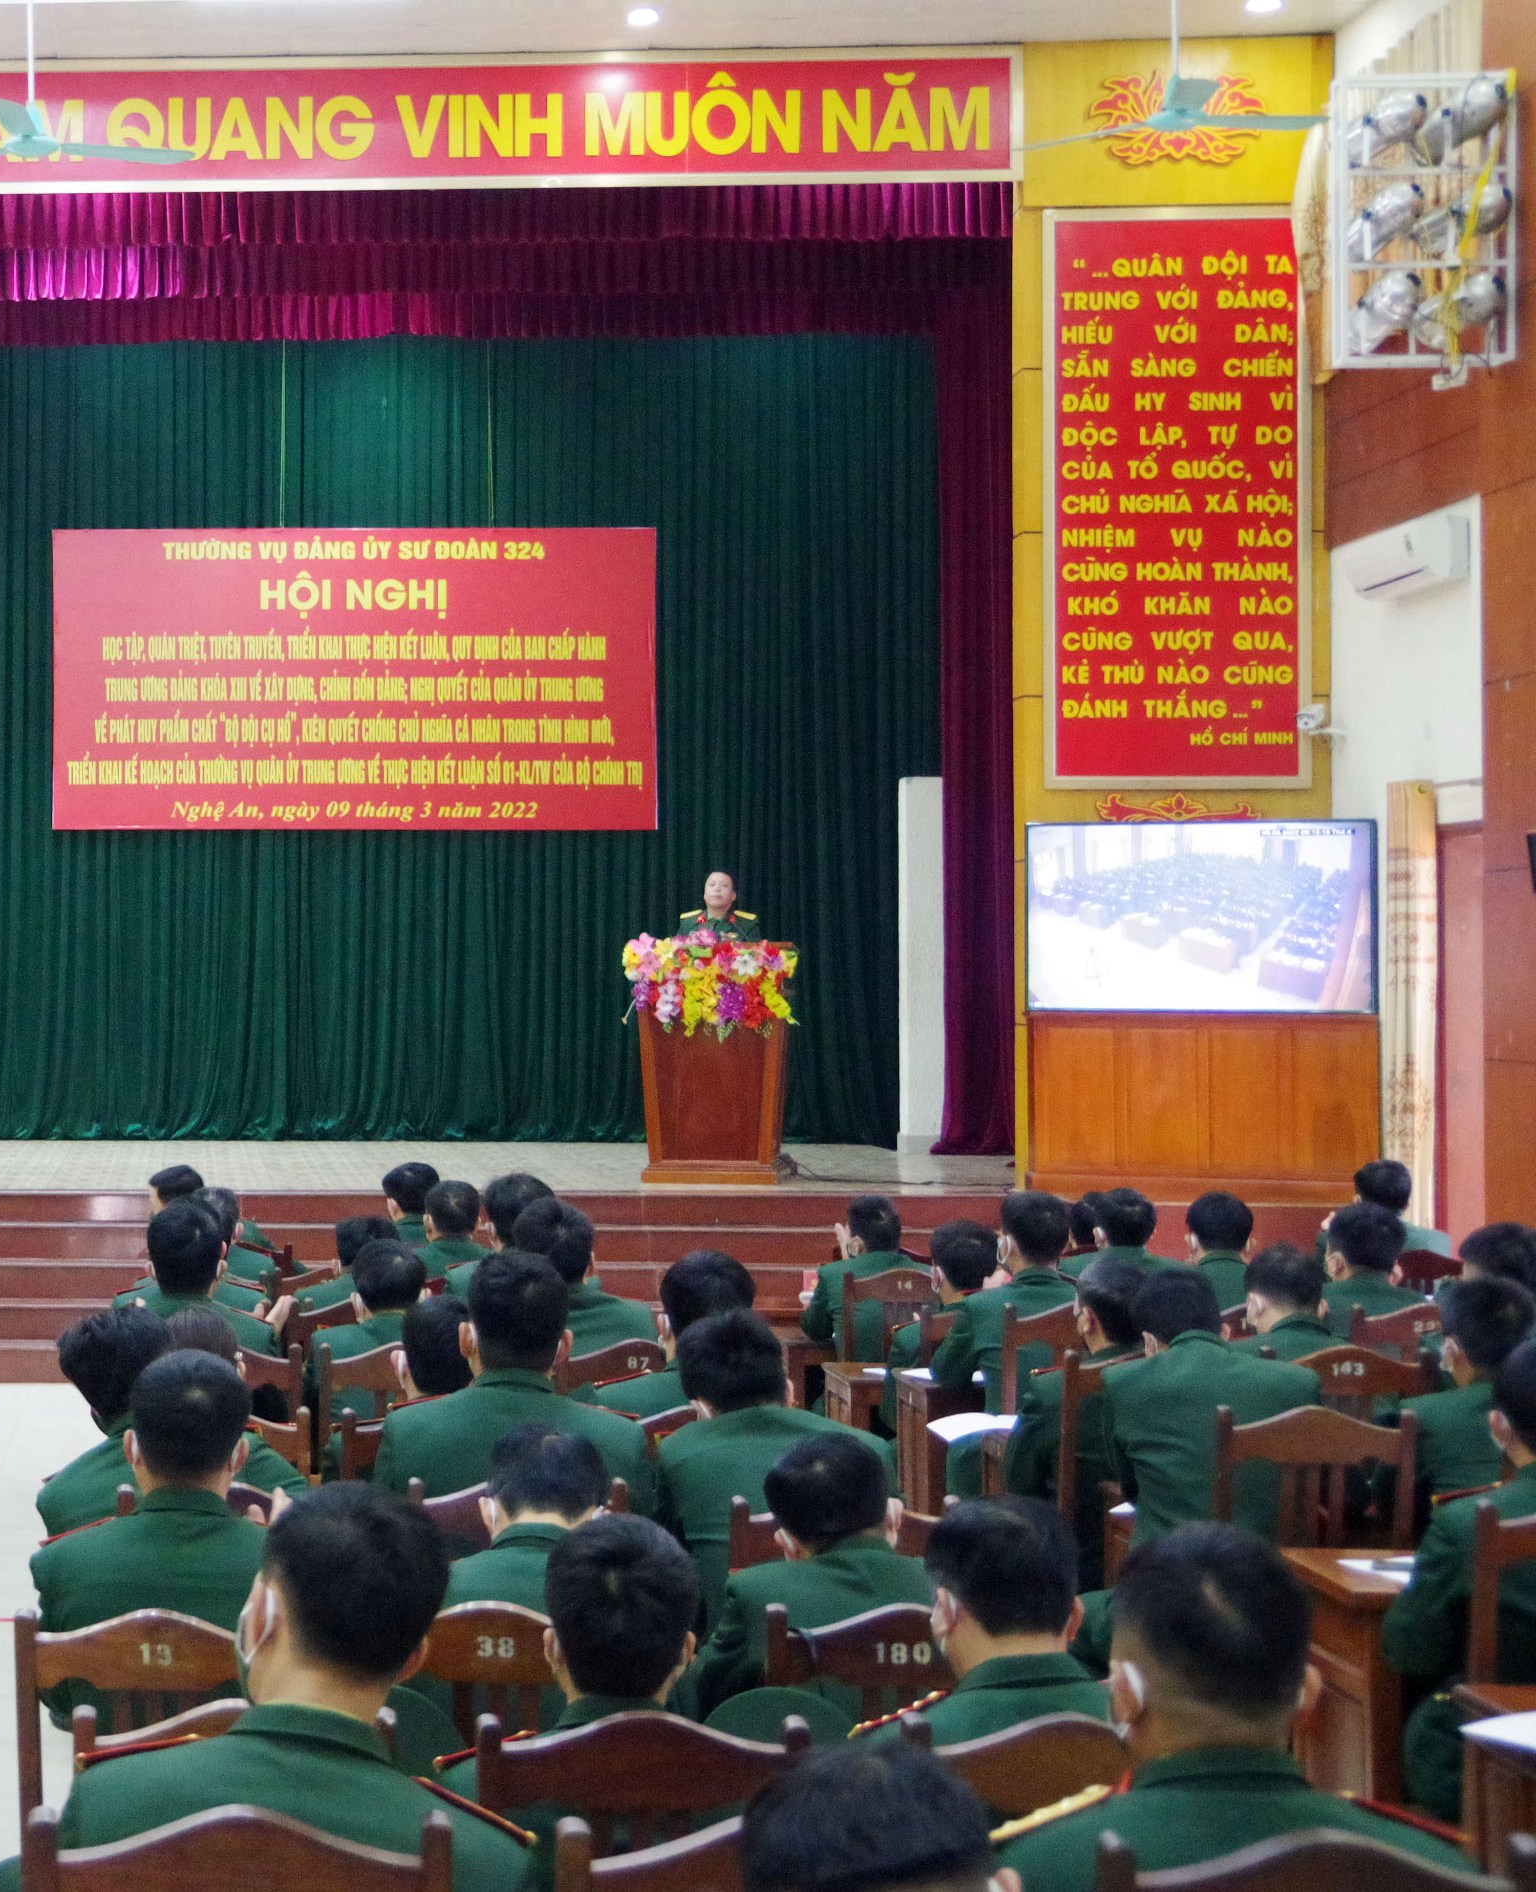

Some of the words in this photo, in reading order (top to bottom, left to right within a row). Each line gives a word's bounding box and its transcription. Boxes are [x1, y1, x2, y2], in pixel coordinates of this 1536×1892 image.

[105, 95, 374, 164] QUANG
[395, 91, 562, 159] VINH
[584, 72, 800, 157] MUÔN
[822, 71, 991, 154] NĂM
[1202, 250, 1247, 280] ĐỘI
[1265, 254, 1294, 275] TA
[1062, 291, 1140, 311] TRUNG
[1156, 284, 1197, 310] VỚI
[1217, 281, 1293, 311] ĐẢNG,
[1062, 317, 1113, 344] HIẾU
[1155, 317, 1196, 343] VỚI
[1235, 318, 1293, 345] DÂN;
[1131, 353, 1196, 377] SÀNG
[1224, 350, 1293, 377] CHIẾN
[1062, 384, 1109, 412] ĐẤU
[1135, 393, 1165, 411] HY
[1189, 392, 1241, 411] SINH
[1270, 385, 1293, 411] VÌ
[1062, 421, 1117, 451] ĐỘC
[1140, 422, 1186, 450] LẬP,
[1208, 424, 1237, 449] TỰ
[1256, 426, 1292, 444] DO
[1062, 489, 1109, 514] CHỦ
[1120, 489, 1192, 513] NGHĨA
[1205, 490, 1238, 513] XÃ
[1247, 489, 1293, 517] HỘI;
[163, 538, 252, 560] THƯỜNG
[259, 542, 287, 563] VỤ
[294, 535, 355, 560] ĐẢNG
[363, 535, 391, 560] ỦY
[398, 540, 431, 560] SƯ
[435, 538, 497, 560] ĐOÀN
[504, 542, 545, 560] 324
[1062, 524, 1135, 552] NHIỆM
[1171, 529, 1202, 551] VỤ
[1238, 522, 1292, 547] NÀO
[260, 570, 331, 619] HỘI
[346, 578, 447, 619] NGHỊ
[1063, 693, 1127, 718] ĐÁNH
[1220, 727, 1247, 745] CHÍ
[1254, 732, 1293, 744] MINH
[171, 801, 225, 822] Nghệ
[229, 802, 264, 820] An,
[271, 801, 320, 822] ngày
[326, 801, 350, 818] 09
[356, 802, 414, 822] tháng
[420, 802, 431, 818] 3
[438, 802, 482, 818] năm
[489, 802, 538, 818] 2022
[627, 1356, 649, 1369] 87
[140, 1643, 172, 1666] 13
[476, 1636, 515, 1659] 38
[875, 1643, 931, 1665] 180
